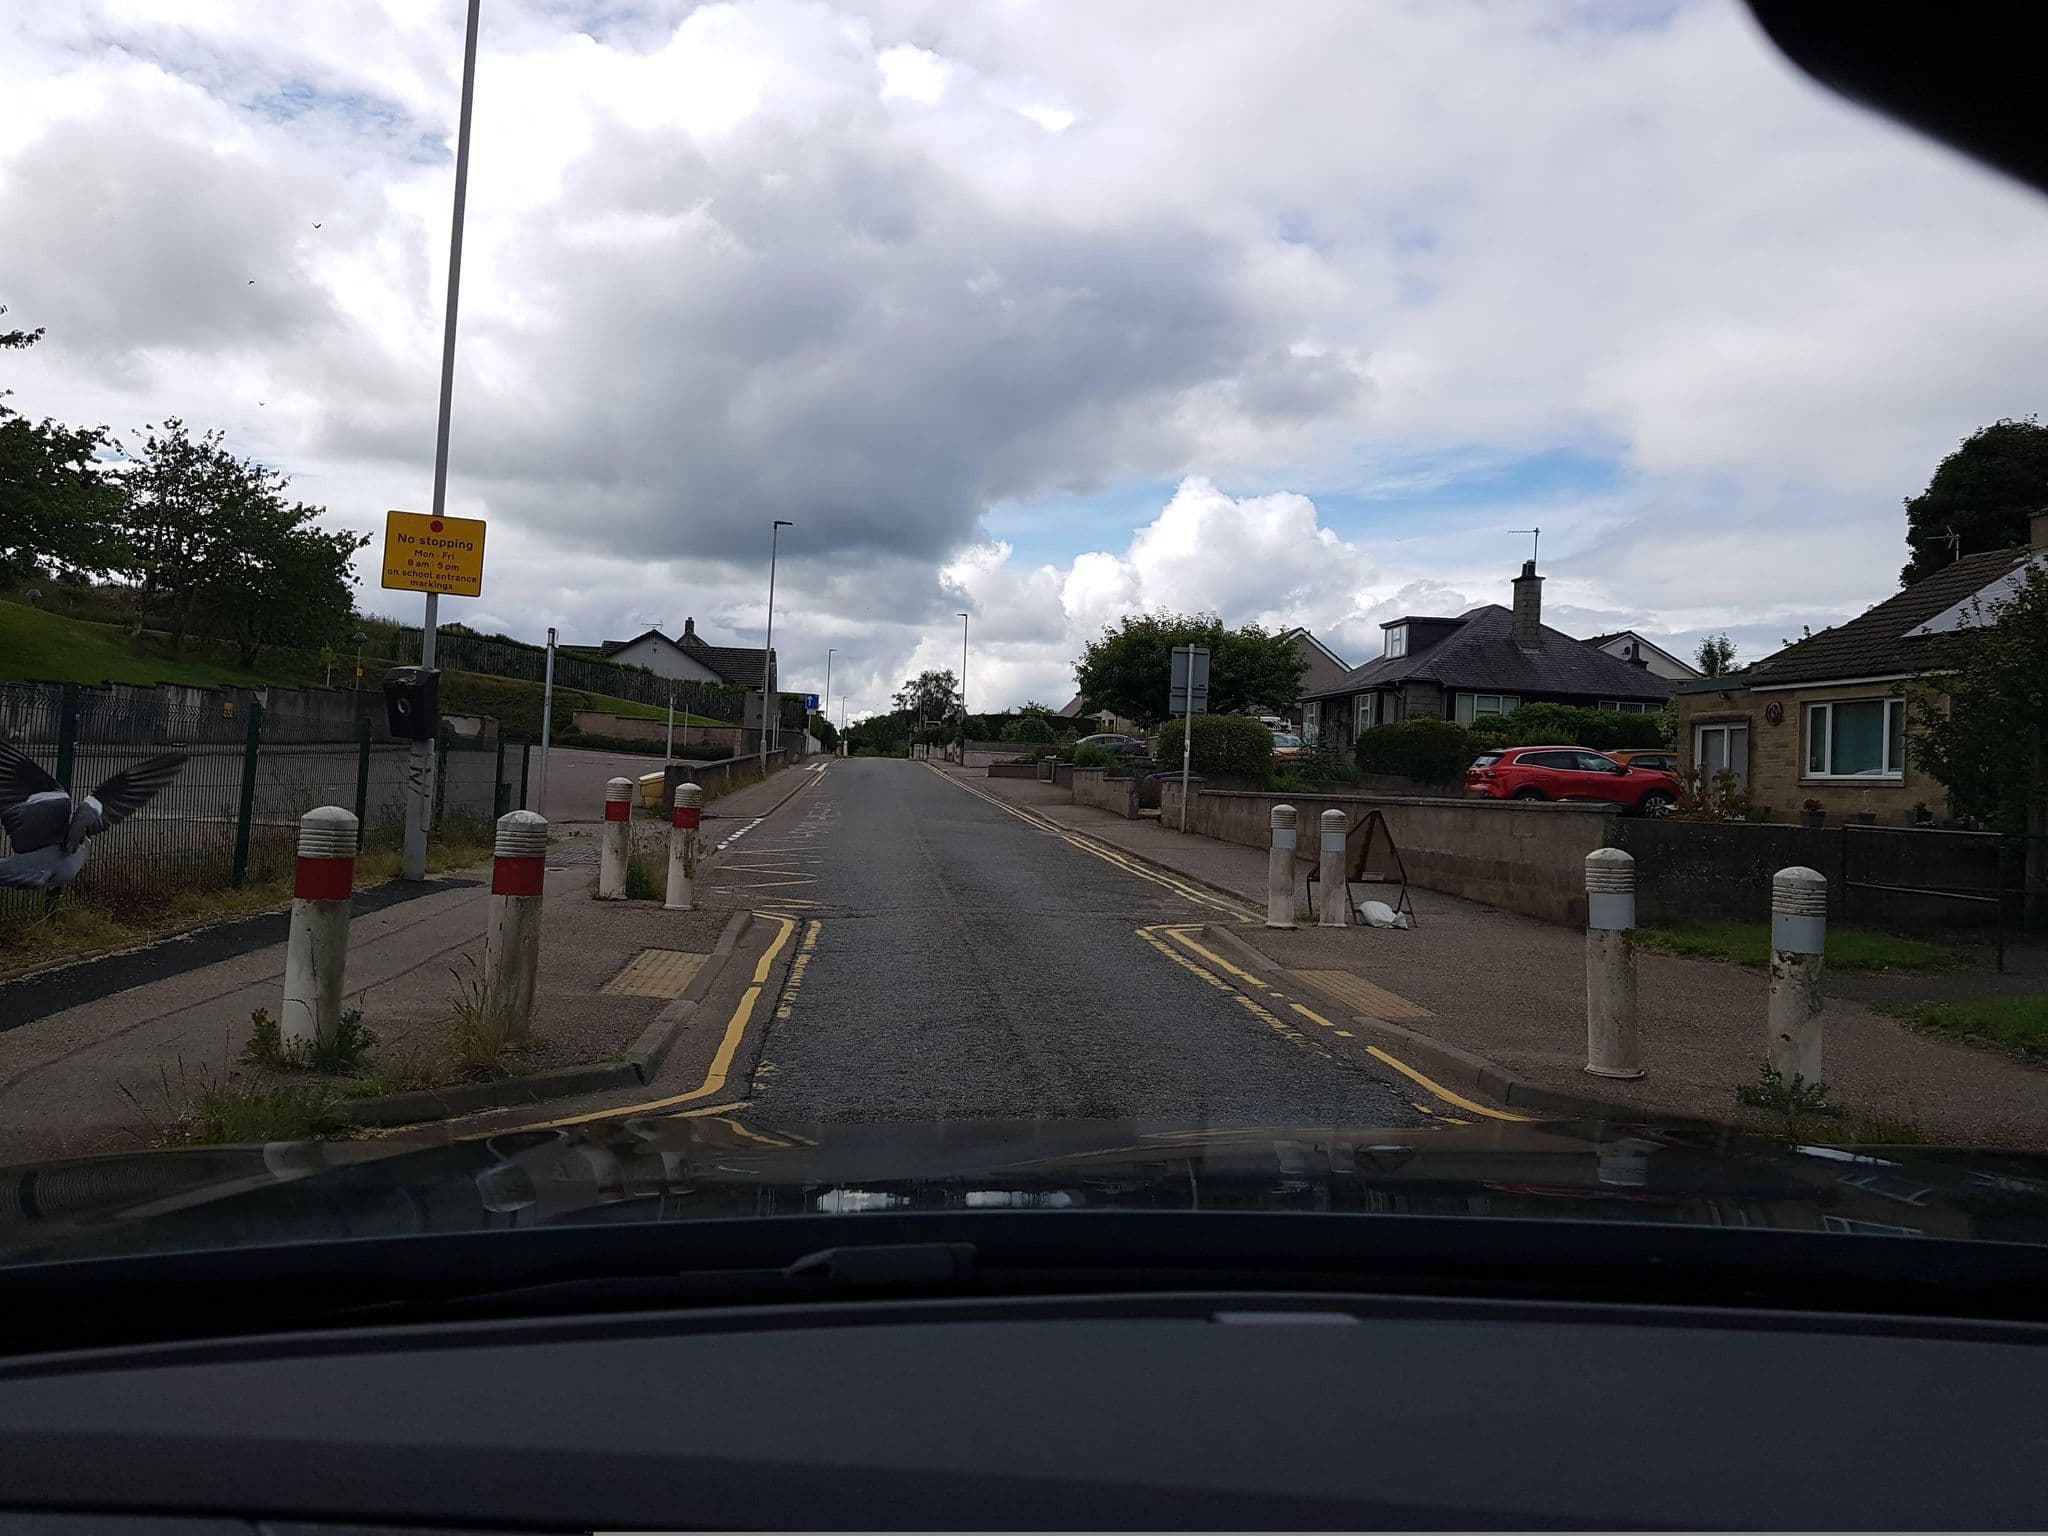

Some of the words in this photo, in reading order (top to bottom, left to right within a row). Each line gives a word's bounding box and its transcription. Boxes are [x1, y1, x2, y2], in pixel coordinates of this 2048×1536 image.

[398, 532, 414, 544] No
[420, 536, 473, 551] stopping
[414, 550, 434, 558] Mon
[402, 569, 432, 579] school
[436, 573, 477, 583] entrance
[410, 579, 453, 590] markings
